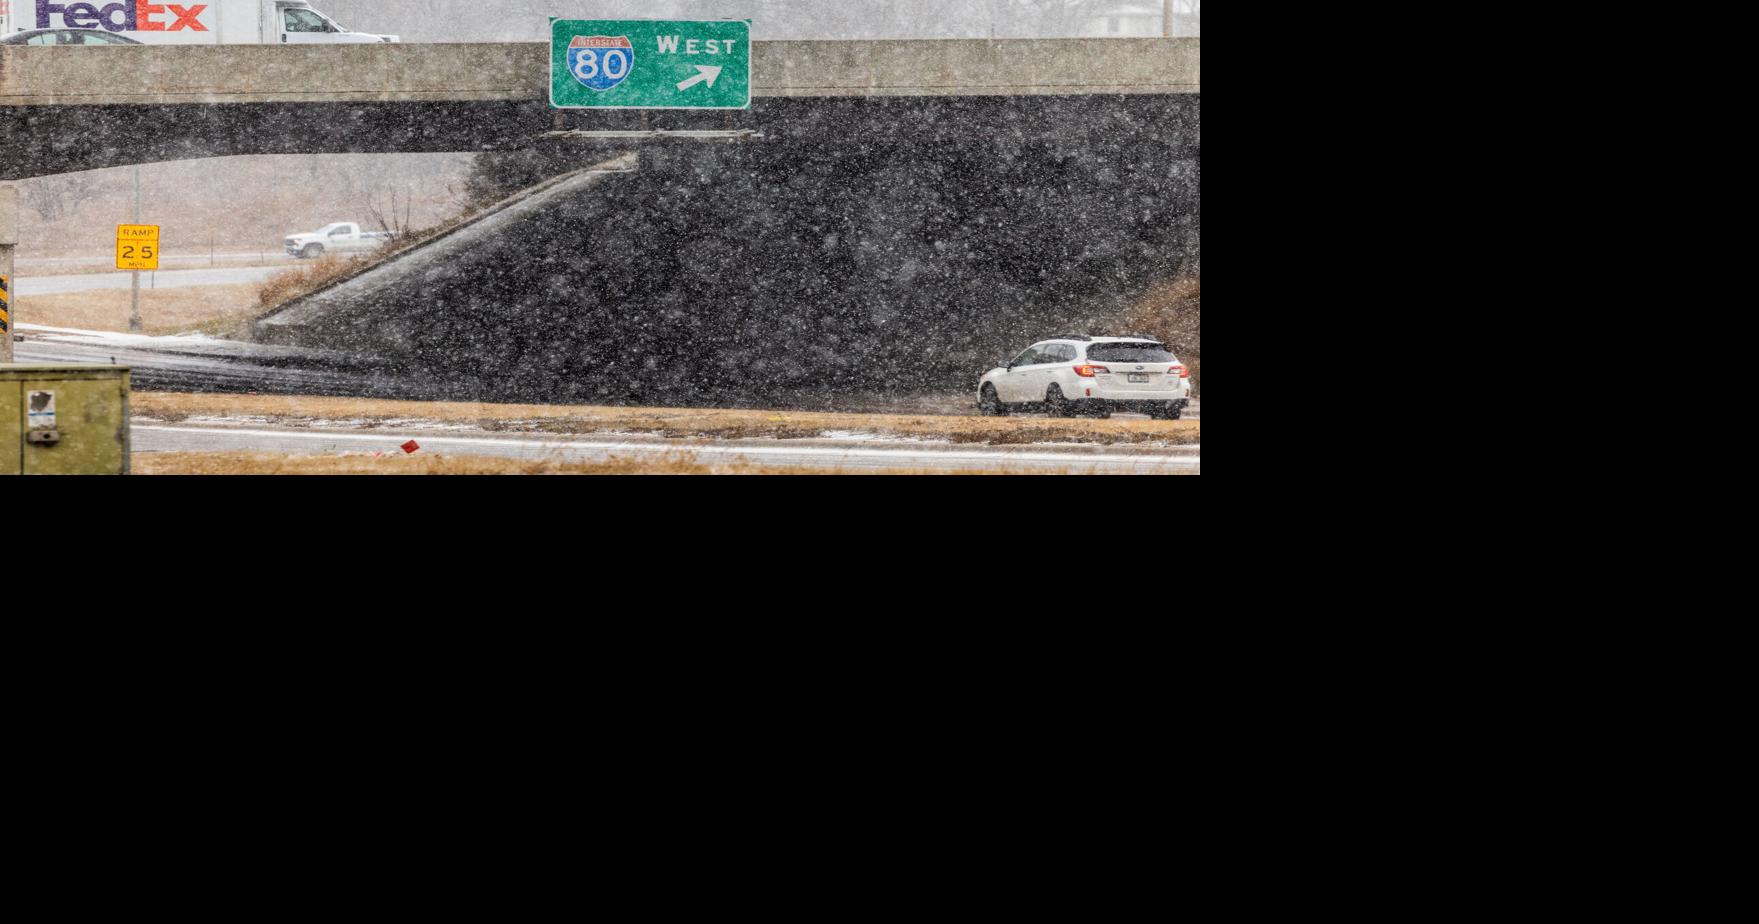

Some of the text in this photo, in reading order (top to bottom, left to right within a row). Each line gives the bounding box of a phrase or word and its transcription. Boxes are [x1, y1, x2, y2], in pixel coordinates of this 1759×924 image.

[36, 0, 208, 32] FedEx
[577, 39, 623, 47] INTERSTATE
[656, 35, 735, 54] WEST
[575, 49, 627, 79] 80
[123, 229, 154, 237] RAMP
[122, 245, 153, 259] 25
